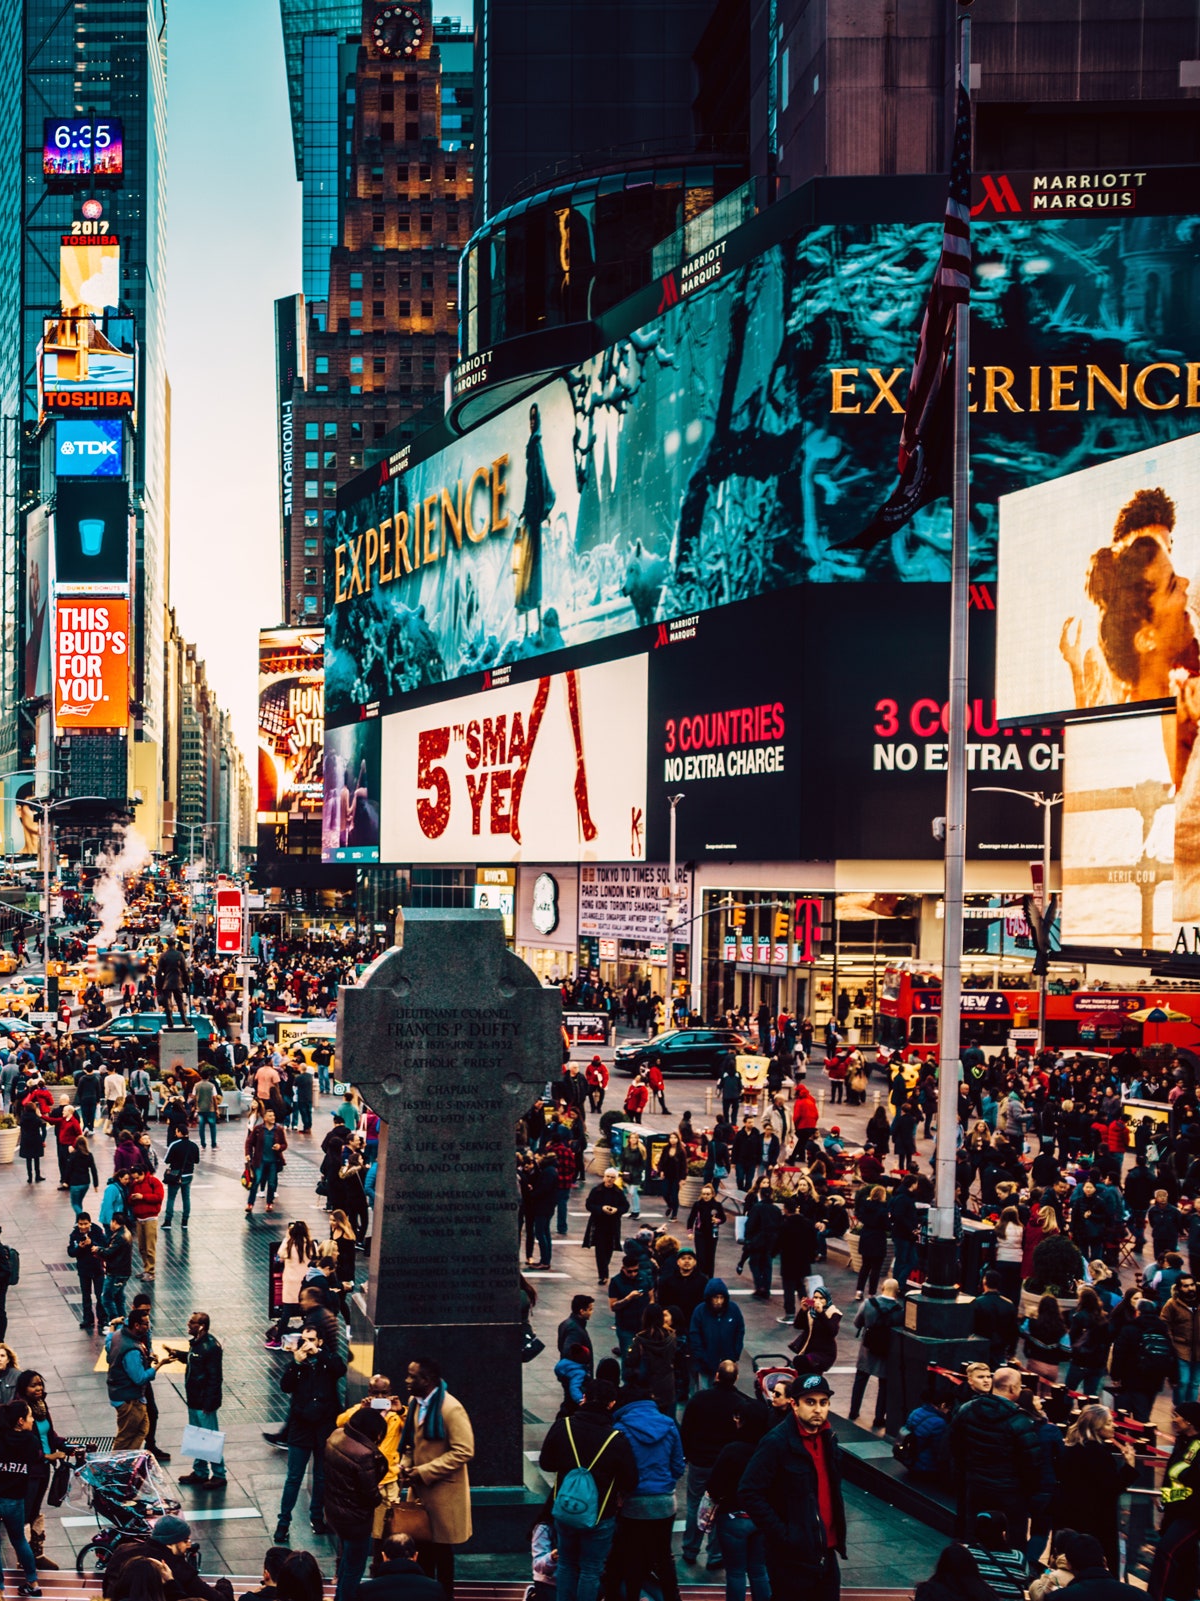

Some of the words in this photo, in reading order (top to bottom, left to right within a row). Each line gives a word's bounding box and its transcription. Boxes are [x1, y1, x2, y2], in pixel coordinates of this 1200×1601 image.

[1033, 173, 1147, 190] MARRIOTT
[1033, 192, 1133, 209] MARQUIS
[71, 221, 110, 235] 2017
[62, 236, 118, 245] TOSHIBA
[681, 241, 727, 278] MARRIOTT
[680, 261, 721, 295] MARQUIS
[829, 363, 1200, 414] EXRIENC
[44, 391, 132, 407] TOSHIBA
[73, 440, 117, 455] TDK
[389, 445, 411, 464] MARRIOTT
[389, 457, 409, 476] MARQUIS
[335, 453, 509, 604] EXPERIENCE
[59, 608, 109, 631] THIS
[670, 615, 699, 631] MARRIOTT
[60, 632, 126, 655] BUD'S
[669, 627, 696, 643] MARQUIS
[60, 655, 102, 678] FOR
[58, 678, 110, 702] YOU.
[665, 718, 678, 753] 3
[679, 702, 785, 750] COUNTRIES
[873, 698, 899, 738] 3
[664, 757, 682, 782] NO
[684, 750, 726, 780] EXTRA
[727, 745, 785, 777] CHARGE
[873, 744, 918, 771] NO
[924, 744, 1022, 771] ETRA
[597, 868, 618, 882] TOKYO
[621, 868, 629, 882] TO
[632, 868, 654, 883] TIMES
[657, 868, 688, 885] SQURE
[1108, 870, 1156, 883] AERIE.COM
[582, 885, 598, 897] PARIS
[600, 885, 624, 898] LONDON
[626, 886, 640, 898] NEW
[643, 886, 659, 898] YORK
[582, 900, 594, 909] HONG
[595, 900, 608, 910] KONG
[610, 901, 632, 911] TORONTO
[387, 1022, 450, 1037] FRANCIS
[465, 1022, 522, 1037] DUFFY
